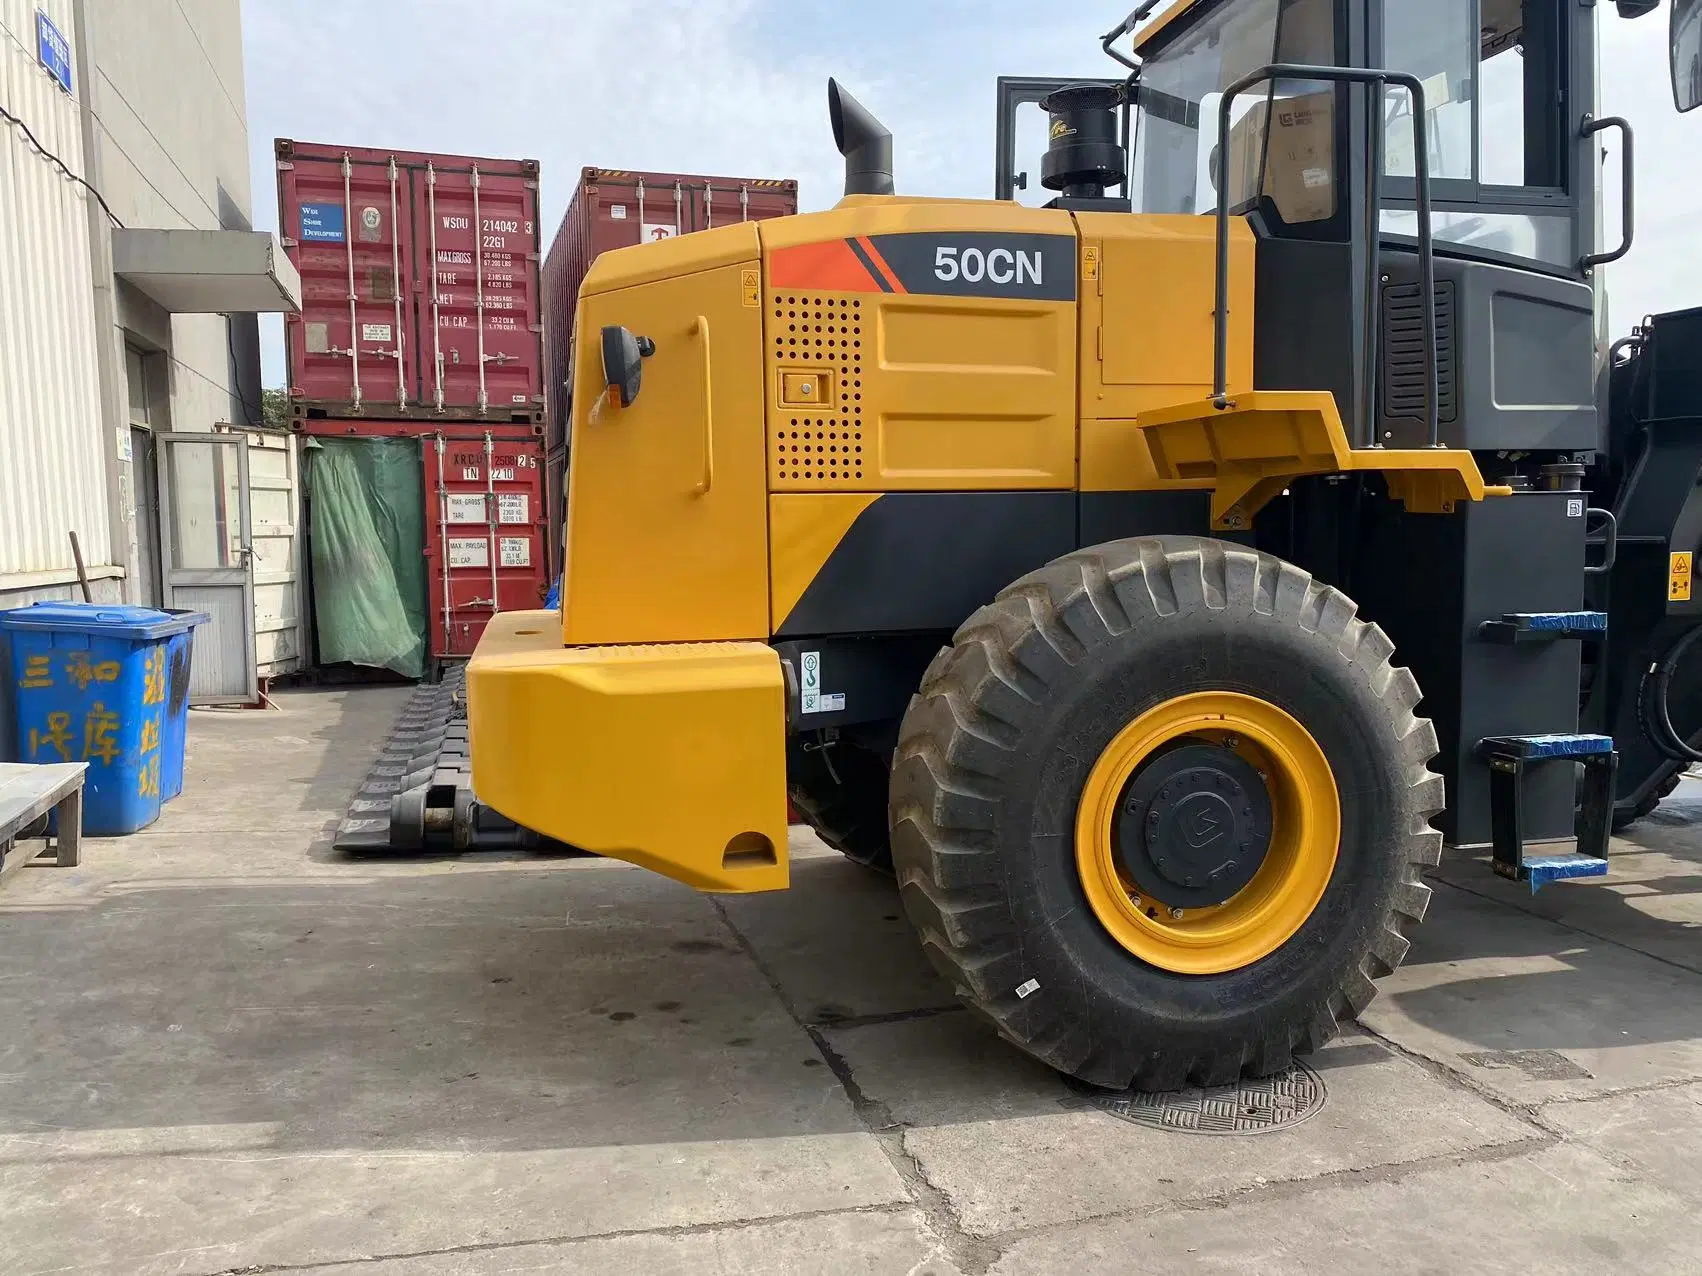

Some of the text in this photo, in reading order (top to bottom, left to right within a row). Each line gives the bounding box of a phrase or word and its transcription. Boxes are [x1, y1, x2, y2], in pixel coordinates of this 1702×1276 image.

[442, 217, 532, 234] WSDU 214042 3
[483, 236, 505, 248] 22G1
[934, 246, 1042, 284] 50CN
[438, 272, 456, 284] TARE
[439, 294, 453, 305] NET
[530, 458, 536, 468] 5
[464, 468, 477, 479] TN
